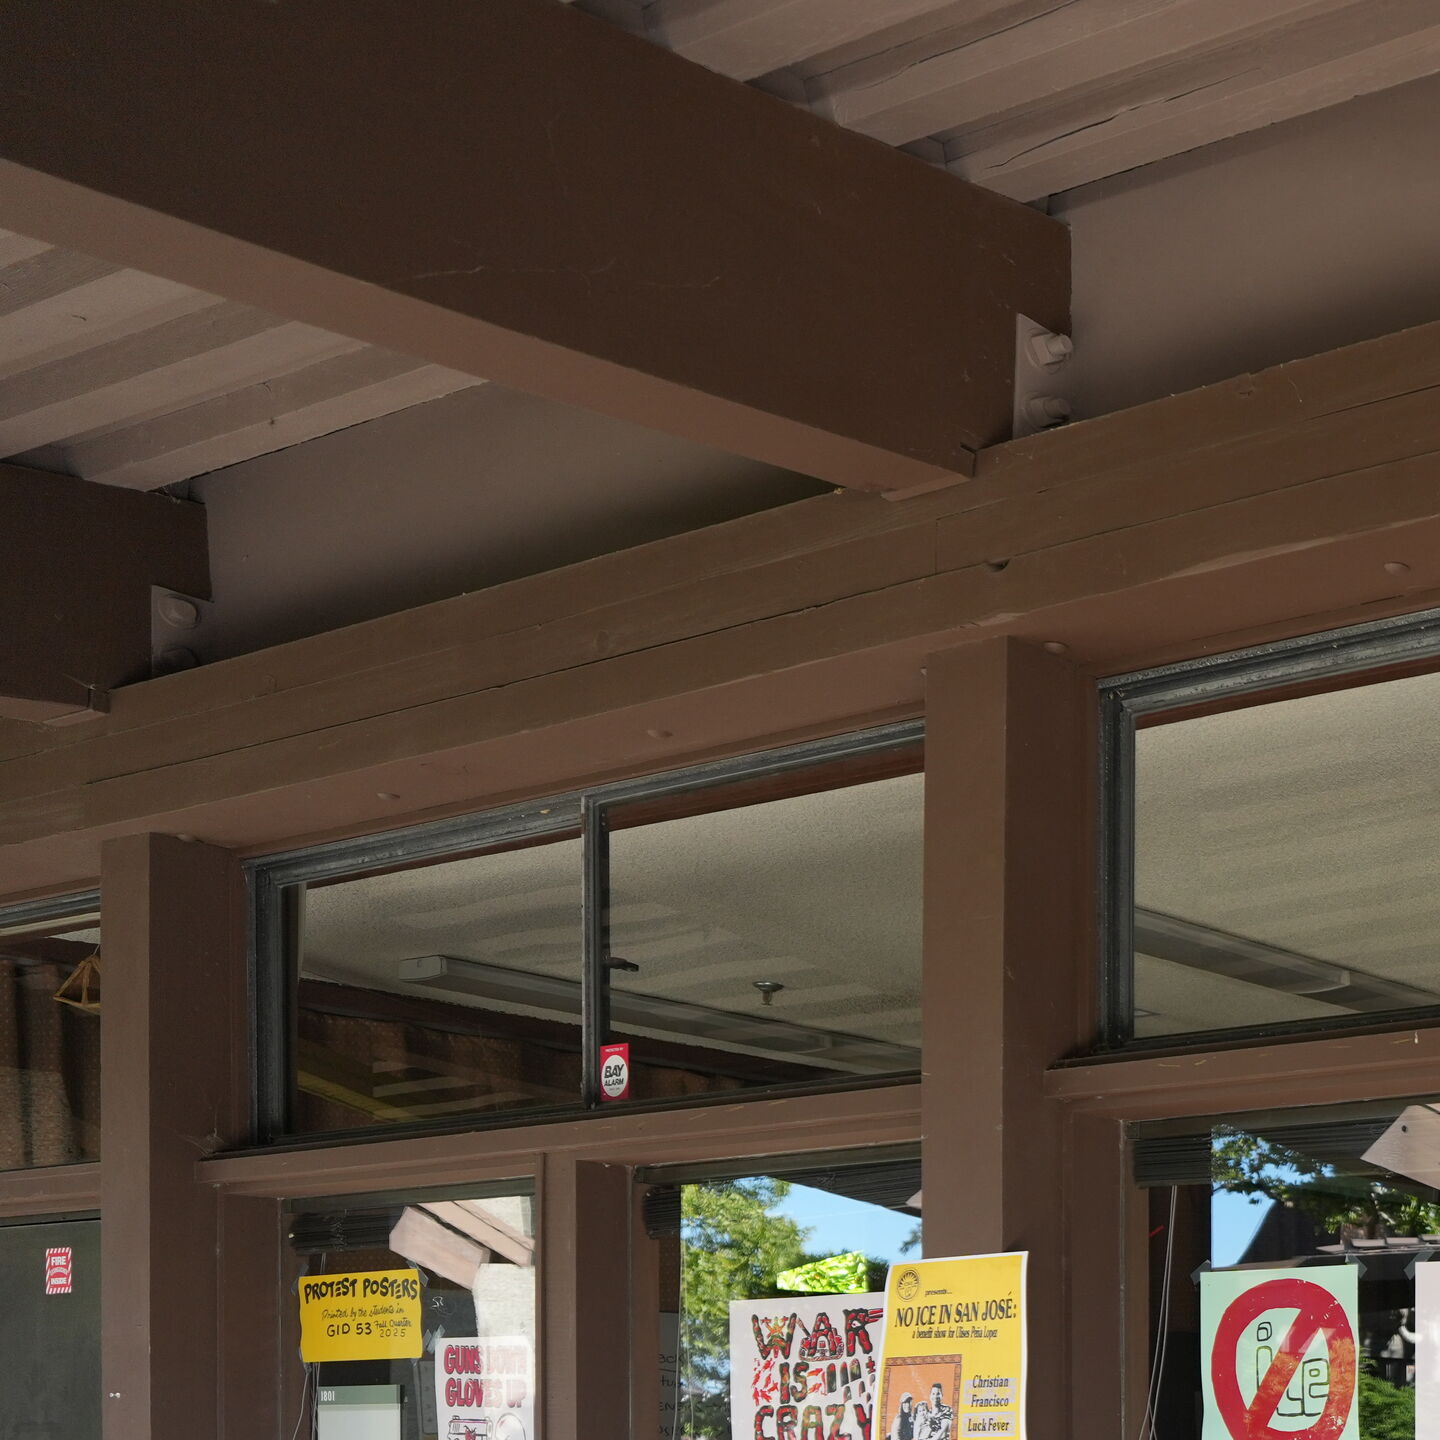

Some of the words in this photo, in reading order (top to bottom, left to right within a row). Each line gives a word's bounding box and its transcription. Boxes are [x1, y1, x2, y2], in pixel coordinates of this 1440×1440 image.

[604, 1064, 624, 1078] BAY
[604, 1078, 624, 1086] ALARM
[51, 1256, 67, 1266] FIRE
[304, 1277, 357, 1304] PROTEST
[363, 1276, 418, 1300] POSTERS
[322, 1308, 348, 1320] Printed
[350, 1307, 357, 1321] by
[358, 1307, 367, 1318] the
[369, 1303, 395, 1318] students
[894, 1306, 914, 1328] NO
[915, 1304, 937, 1327] ICE
[938, 1303, 953, 1325] IN
[954, 1301, 980, 1324] SAN
[981, 1291, 1017, 1322] JOSÉ:
[326, 1323, 351, 1338] GID
[356, 1322, 372, 1336] 53
[373, 1320, 387, 1329] Fall
[390, 1317, 413, 1328] Quarter
[379, 1329, 407, 1338] 2025
[751, 1308, 876, 1361] WAR
[916, 1326, 933, 1339] benefit
[933, 1326, 947, 1338] show
[947, 1327, 955, 1338] for
[983, 1325, 998, 1340] Lopez
[444, 1344, 484, 1374] GUNS
[972, 1374, 1009, 1388] Christian
[970, 1394, 1010, 1407] Francisco
[967, 1418, 986, 1432] Luck
[987, 1417, 1010, 1432] Fever
